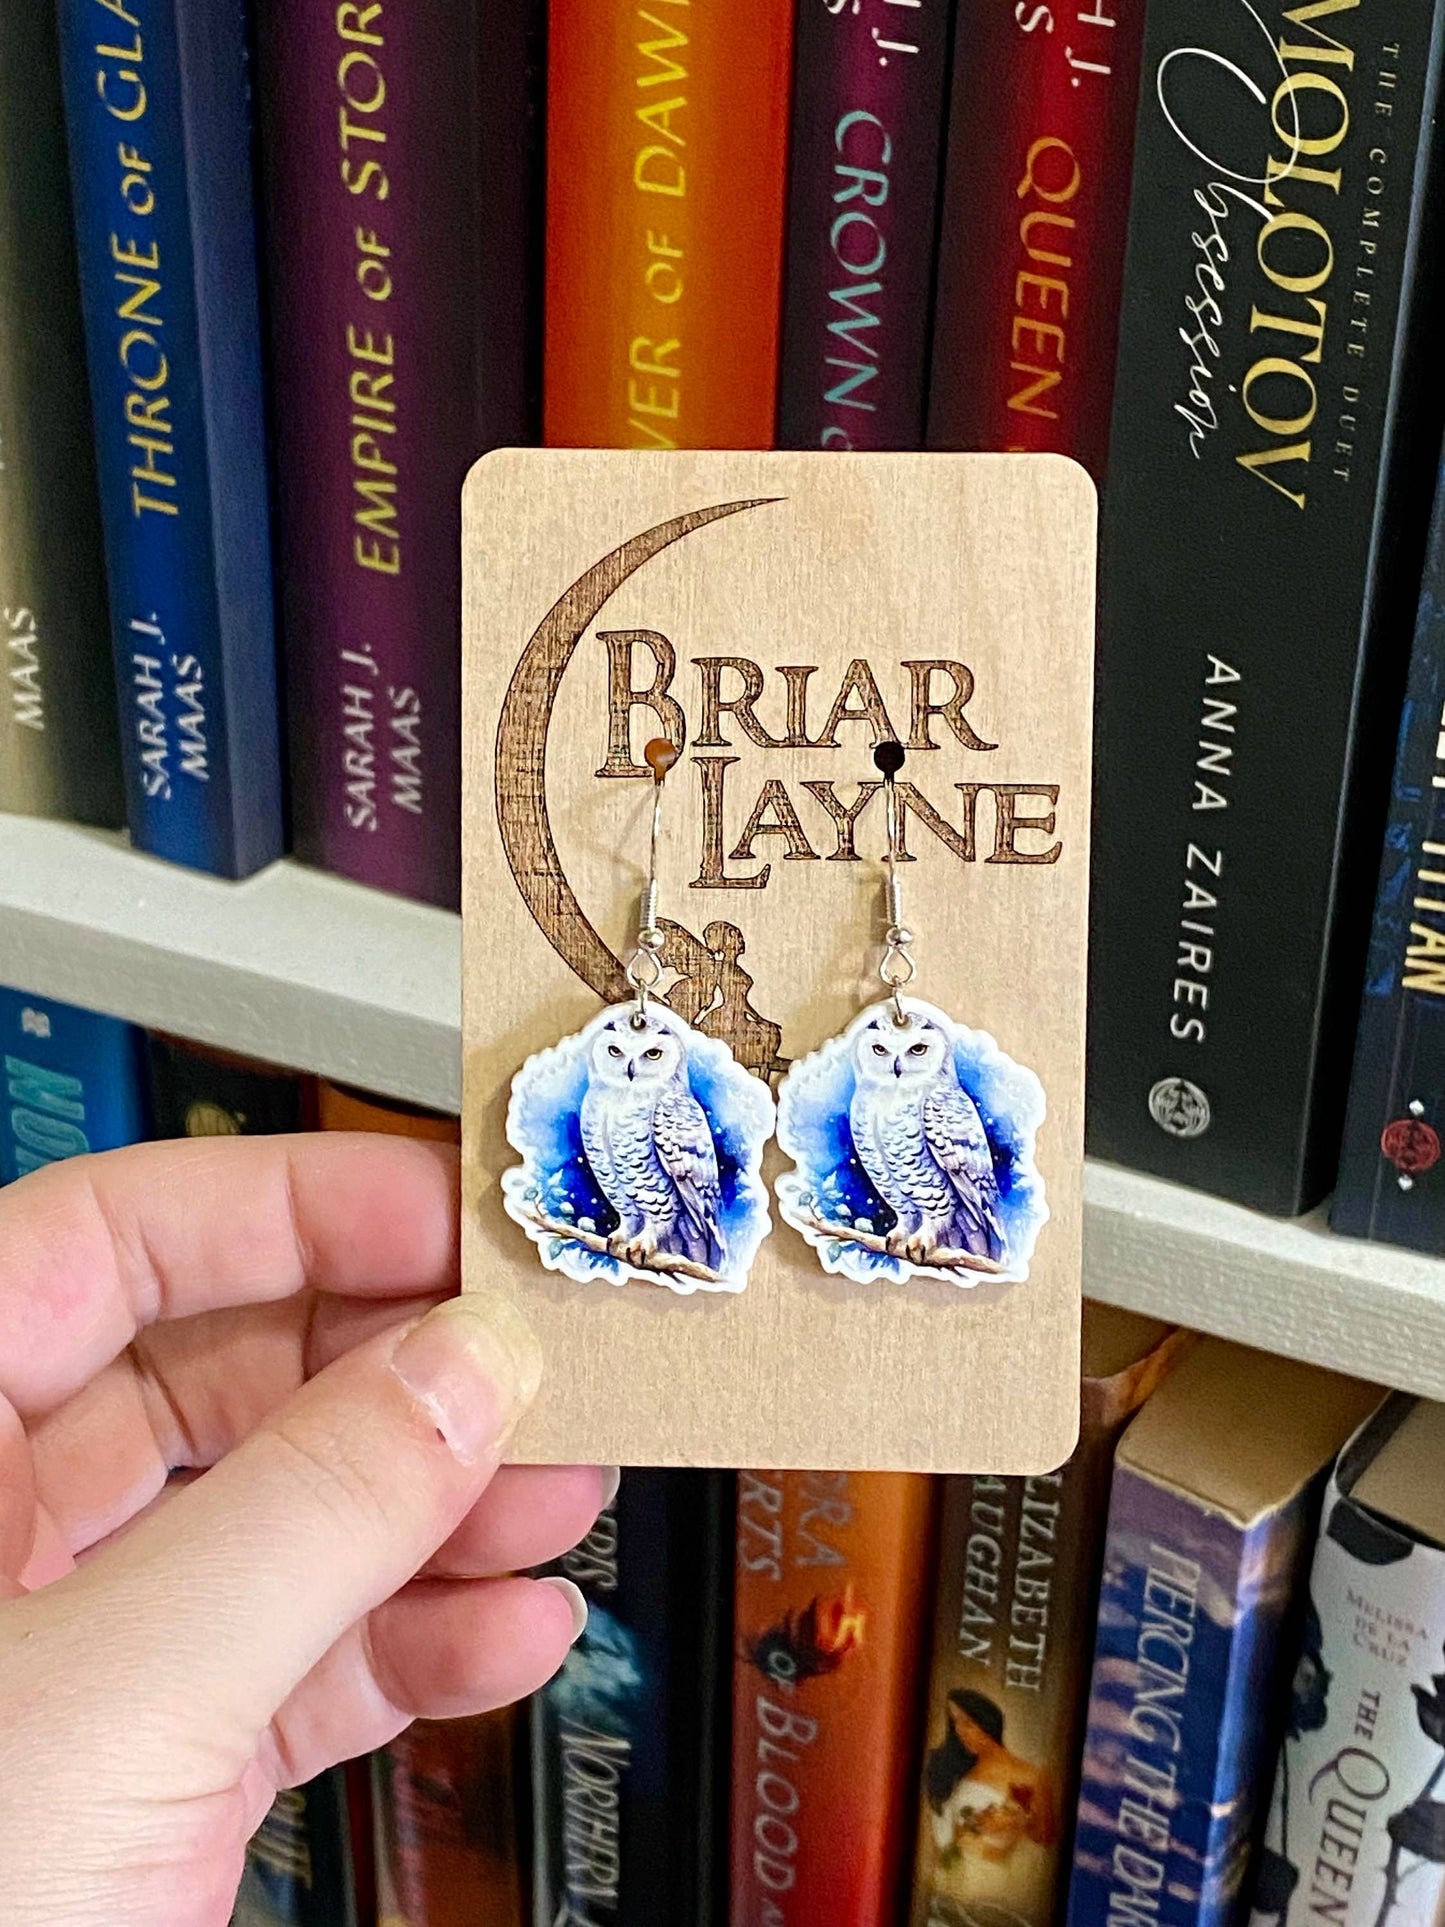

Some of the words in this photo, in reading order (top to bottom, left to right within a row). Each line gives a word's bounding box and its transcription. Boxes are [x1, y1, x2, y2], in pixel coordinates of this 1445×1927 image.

[633, 0, 691, 197] DAW
[1064, 45, 1112, 88] J.
[1374, 42, 1400, 117] THE
[118, 142, 155, 216] OF
[1157, 0, 1300, 460] Obsession
[354, 226, 391, 301] OF
[645, 230, 684, 304] OF
[823, 110, 892, 411] CROWN
[1006, 136, 1083, 420] QUEEN
[1235, 0, 1361, 510] MOLOTOV
[1346, 147, 1388, 359] COMPLETE
[111, 233, 179, 519] THRONE
[346, 323, 400, 575] EMPIRE
[1333, 385, 1360, 482] DUET
[4, 607, 45, 730] MAAS
[128, 611, 166, 645] J.
[339, 643, 379, 676] J.
[133, 654, 172, 800] SARAH
[172, 653, 210, 780] MAAS
[342, 685, 377, 831] SARAH
[387, 686, 423, 814] MAAS
[594, 629, 999, 778] BRIAR
[1191, 653, 1241, 810] ANNA
[689, 756, 1063, 889] LAYNE
[1169, 843, 1223, 1043] ZAIRES
[1126, 1543, 1198, 1752] PIERCING
[1355, 1687, 1381, 1741] THE
[561, 1718, 632, 1910] NORTHERN
[754, 1696, 818, 1892] BLOOD
[1118, 1755, 1177, 1851] THE
[1308, 1747, 1390, 1927] QUEEN
